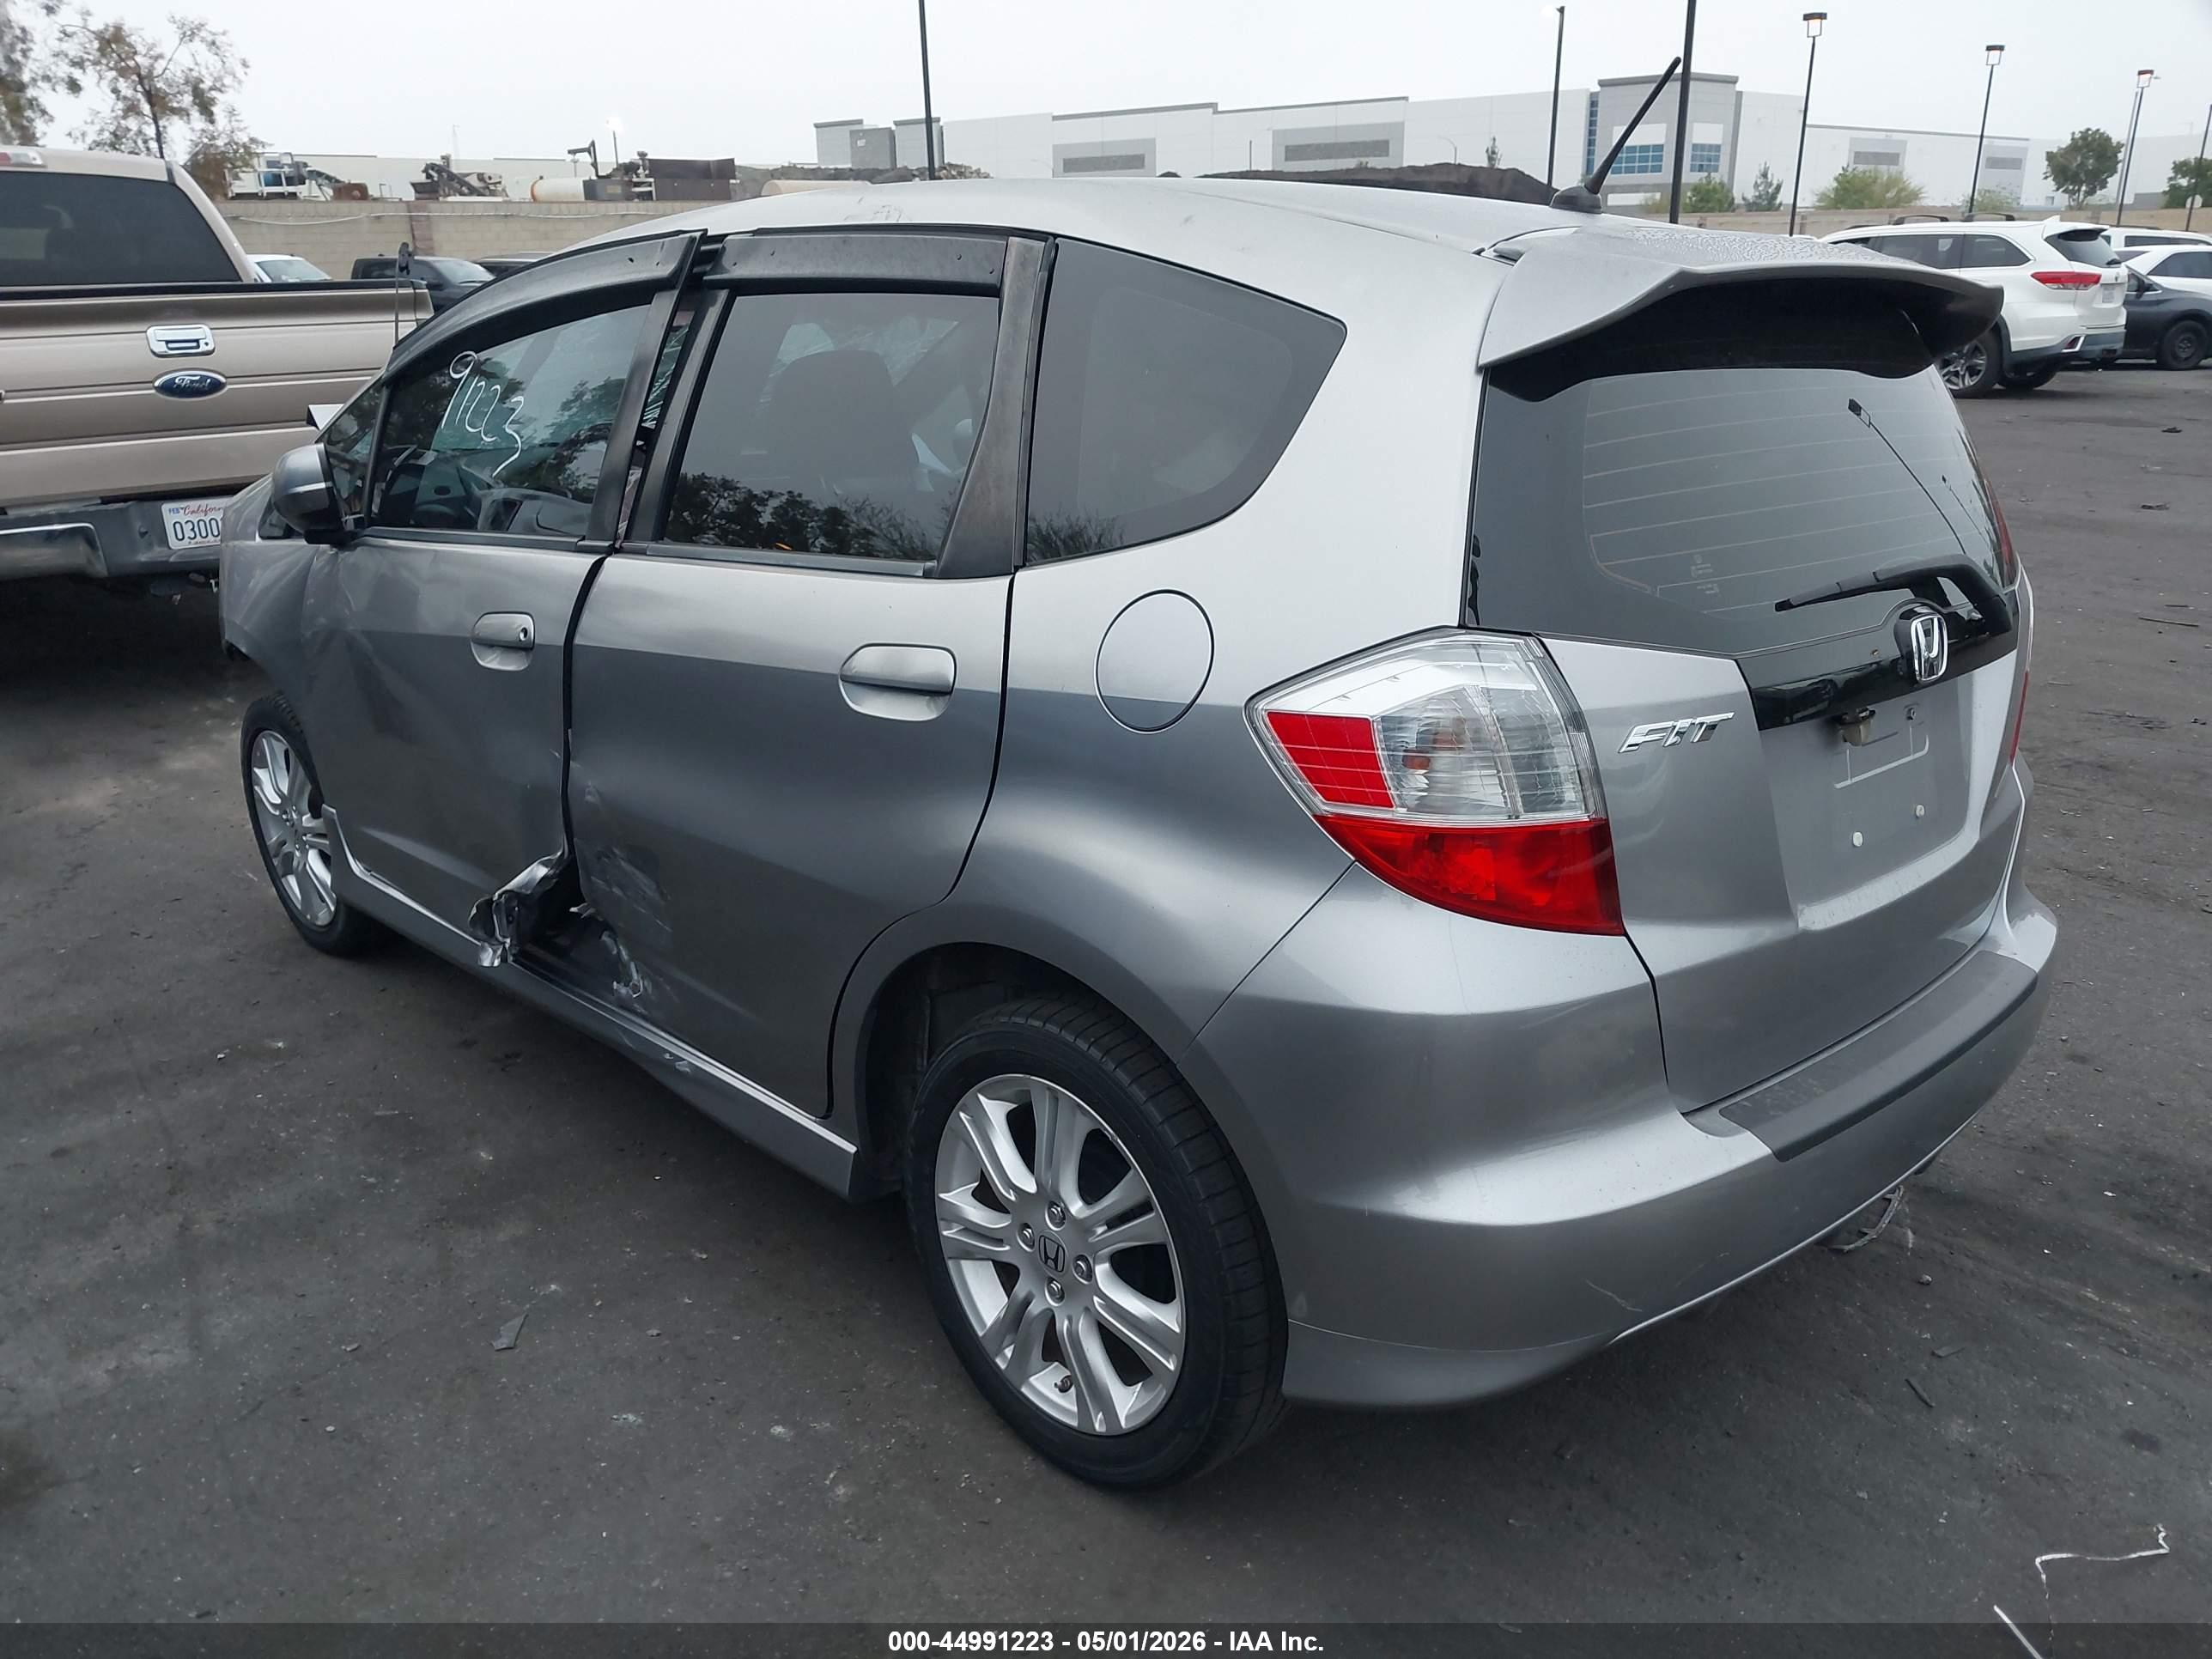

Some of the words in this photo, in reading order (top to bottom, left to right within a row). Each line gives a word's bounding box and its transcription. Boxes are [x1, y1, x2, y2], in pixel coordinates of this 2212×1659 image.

[173, 375, 211, 390] Ford
[441, 350, 525, 478] 91223
[173, 517, 222, 542] 0300
[1618, 712, 1735, 753] FIT
